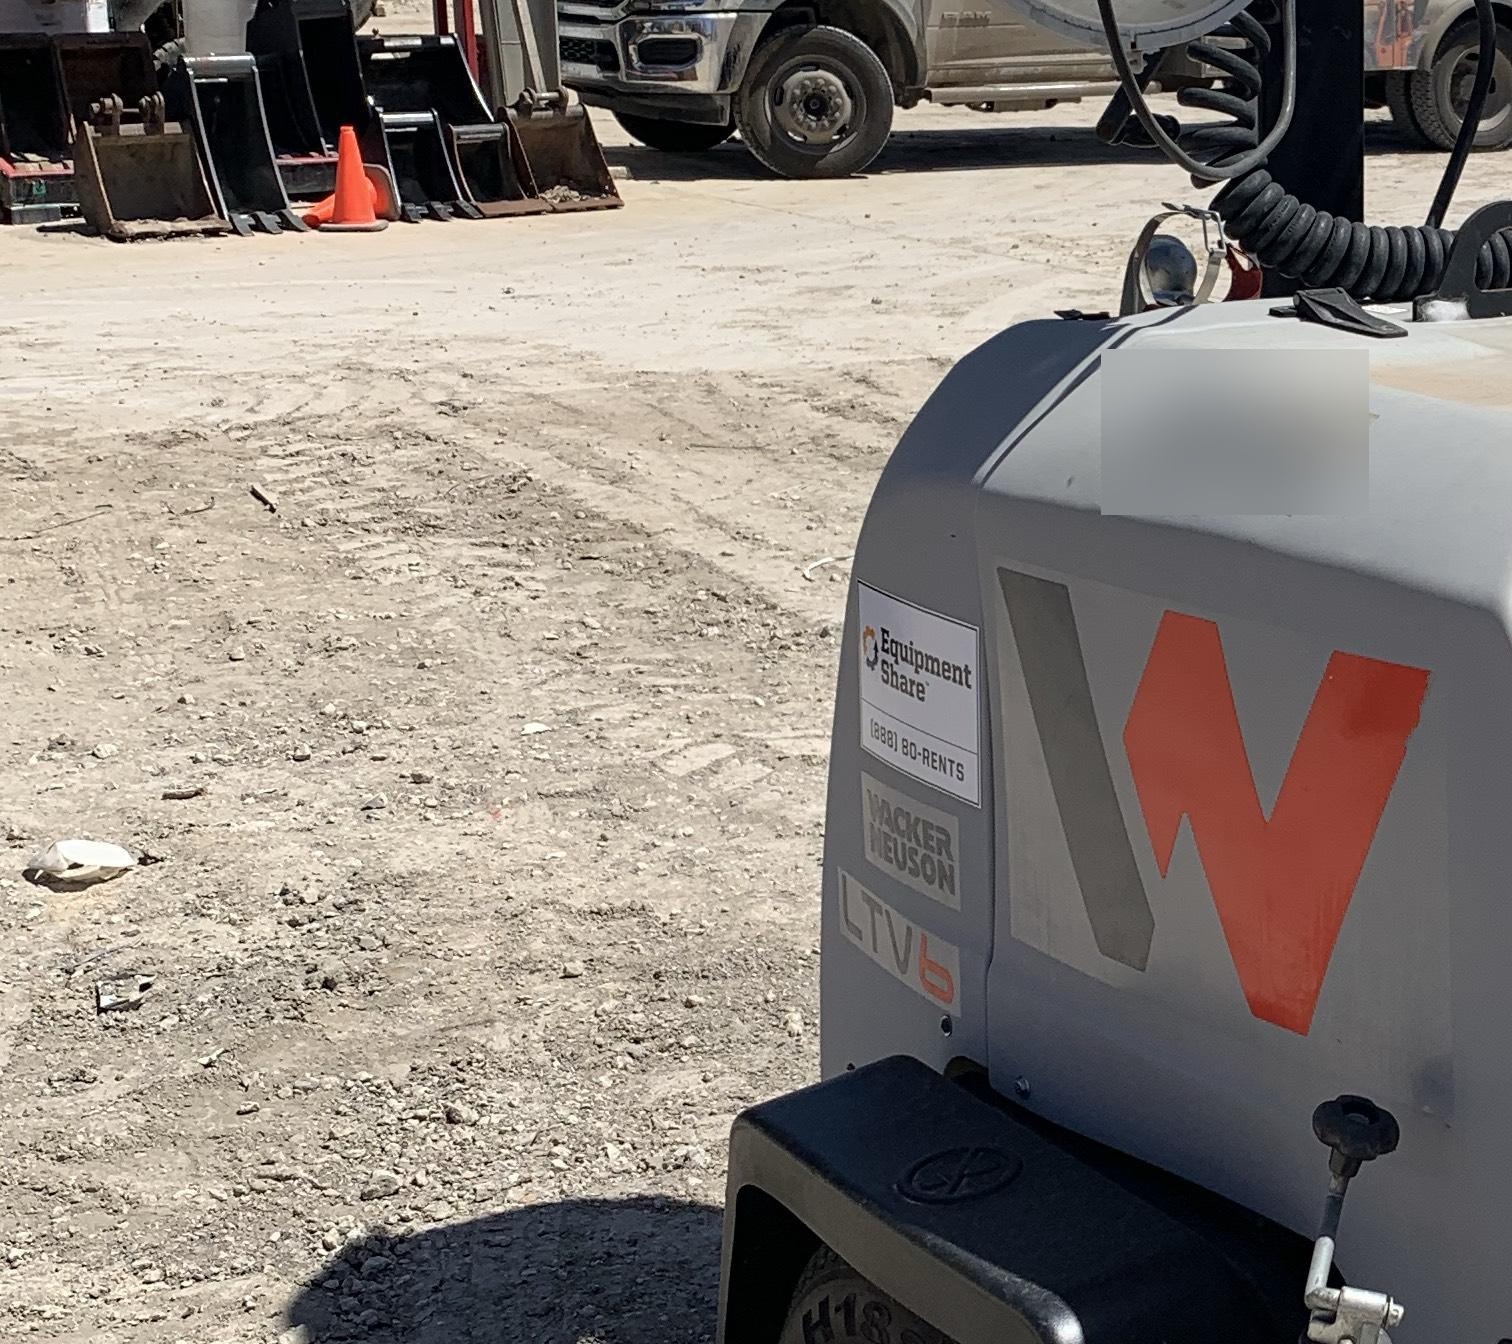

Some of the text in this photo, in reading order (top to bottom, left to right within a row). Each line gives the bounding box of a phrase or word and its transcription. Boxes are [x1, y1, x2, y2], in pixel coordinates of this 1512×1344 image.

[880, 627, 972, 689] Equipment
[880, 660, 926, 702] Share
[870, 718, 965, 782] (888) 80-RENTS
[866, 788, 954, 862] WACKER
[868, 821, 956, 896] NEUSON
